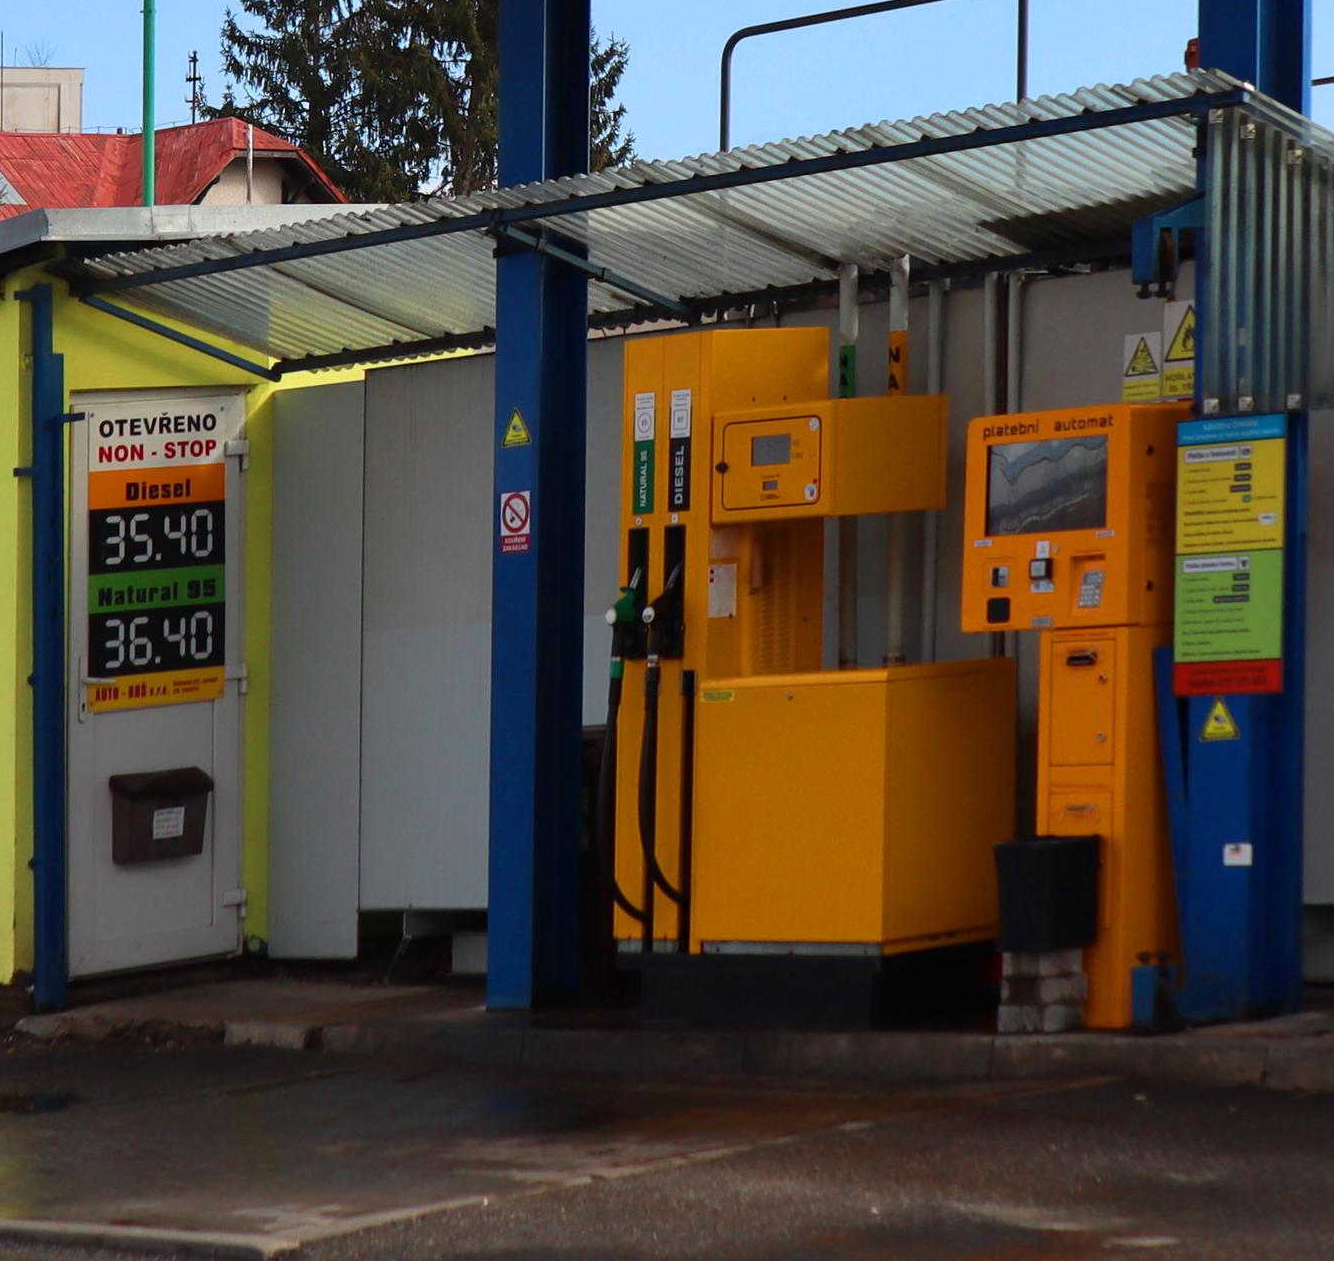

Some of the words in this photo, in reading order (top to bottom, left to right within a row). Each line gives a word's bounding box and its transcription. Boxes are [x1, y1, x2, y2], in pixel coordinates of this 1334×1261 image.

[99, 412, 217, 438] OTEVŘENO
[983, 420, 1039, 440] platební
[1054, 415, 1114, 432] automat
[99, 444, 144, 463] NON
[164, 439, 217, 459] STOP
[639, 463, 647, 507] NATURAL
[674, 445, 684, 505] DIESEL
[126, 478, 191, 501] Diesel
[106, 509, 213, 565] 35.40
[98, 582, 178, 607] Natural
[187, 579, 217, 598] 95
[105, 611, 213, 668] 36.40
[95, 687, 119, 702] AUTO
